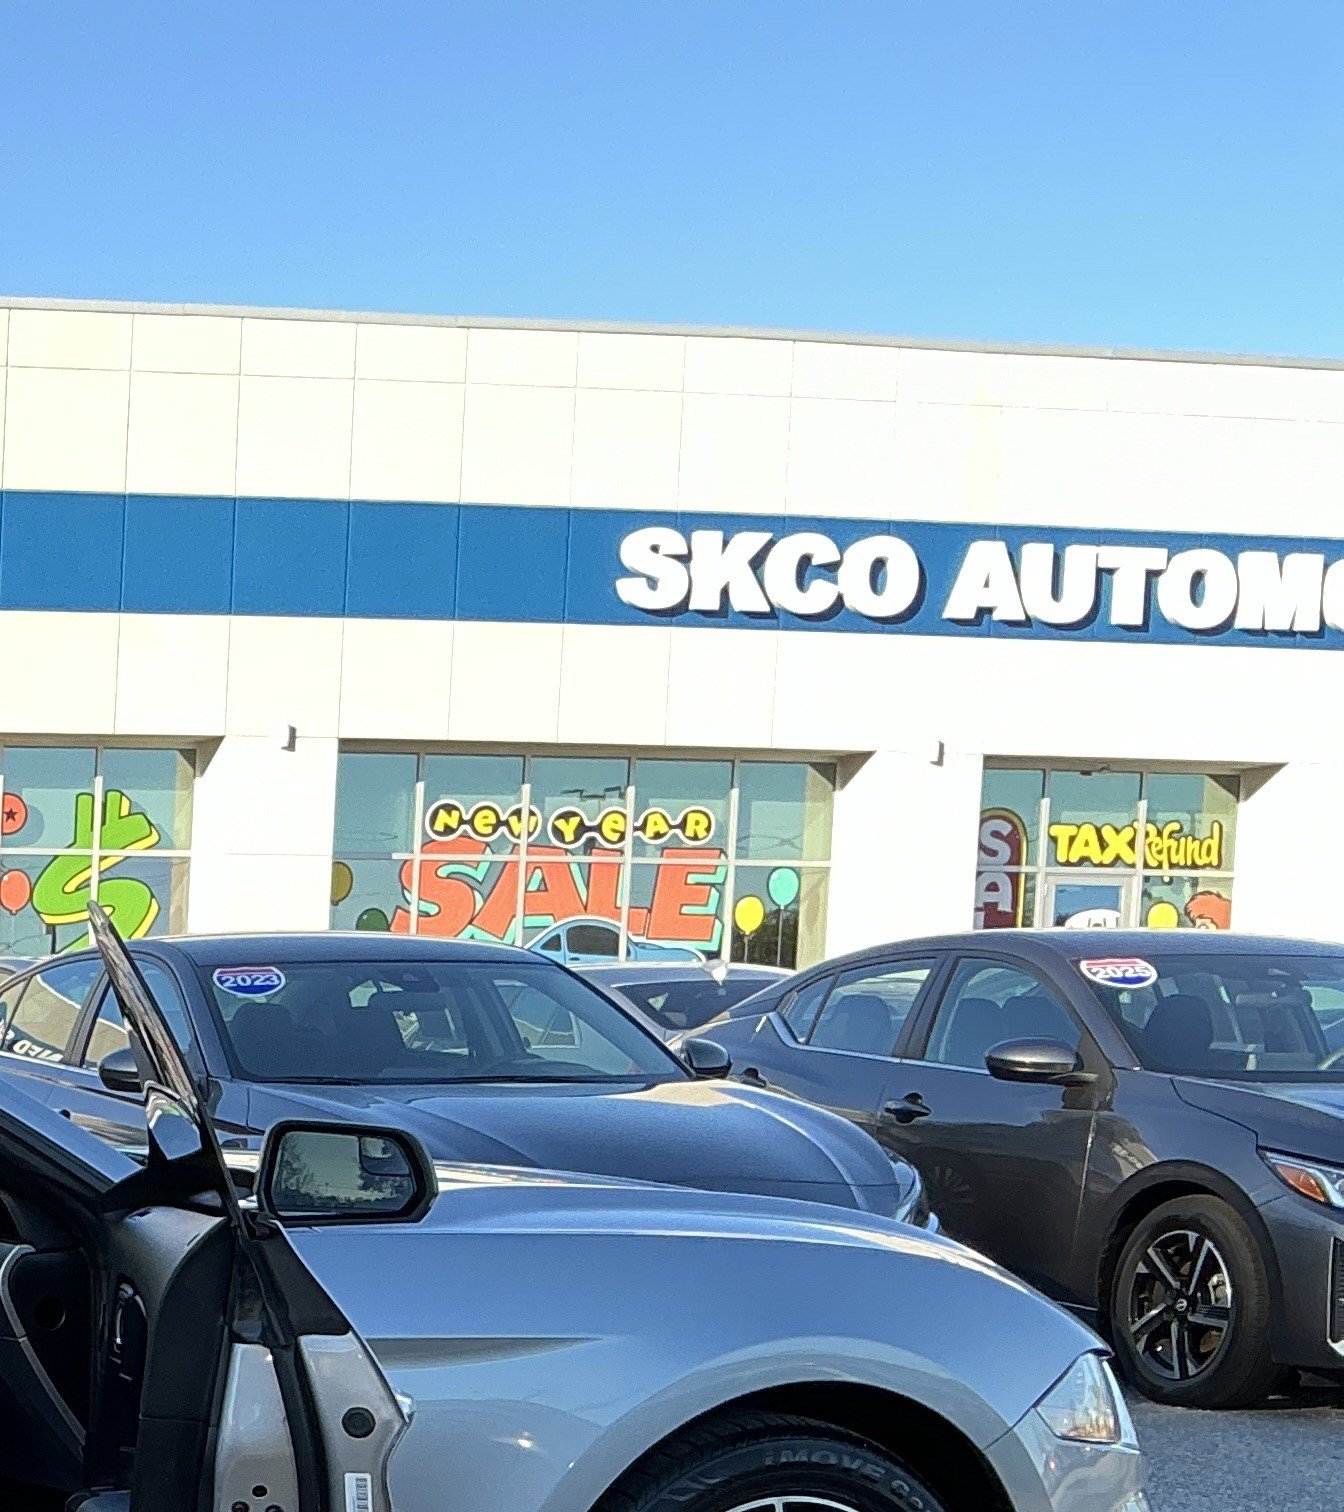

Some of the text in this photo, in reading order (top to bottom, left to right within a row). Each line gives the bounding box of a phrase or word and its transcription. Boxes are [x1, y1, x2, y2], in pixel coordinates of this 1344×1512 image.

[615, 526, 1344, 631] SKCO AUTOM
[1049, 822, 1135, 864] TAX
[390, 836, 724, 946] SALE
[221, 974, 280, 987] 2023
[1091, 966, 1151, 979] 2025
